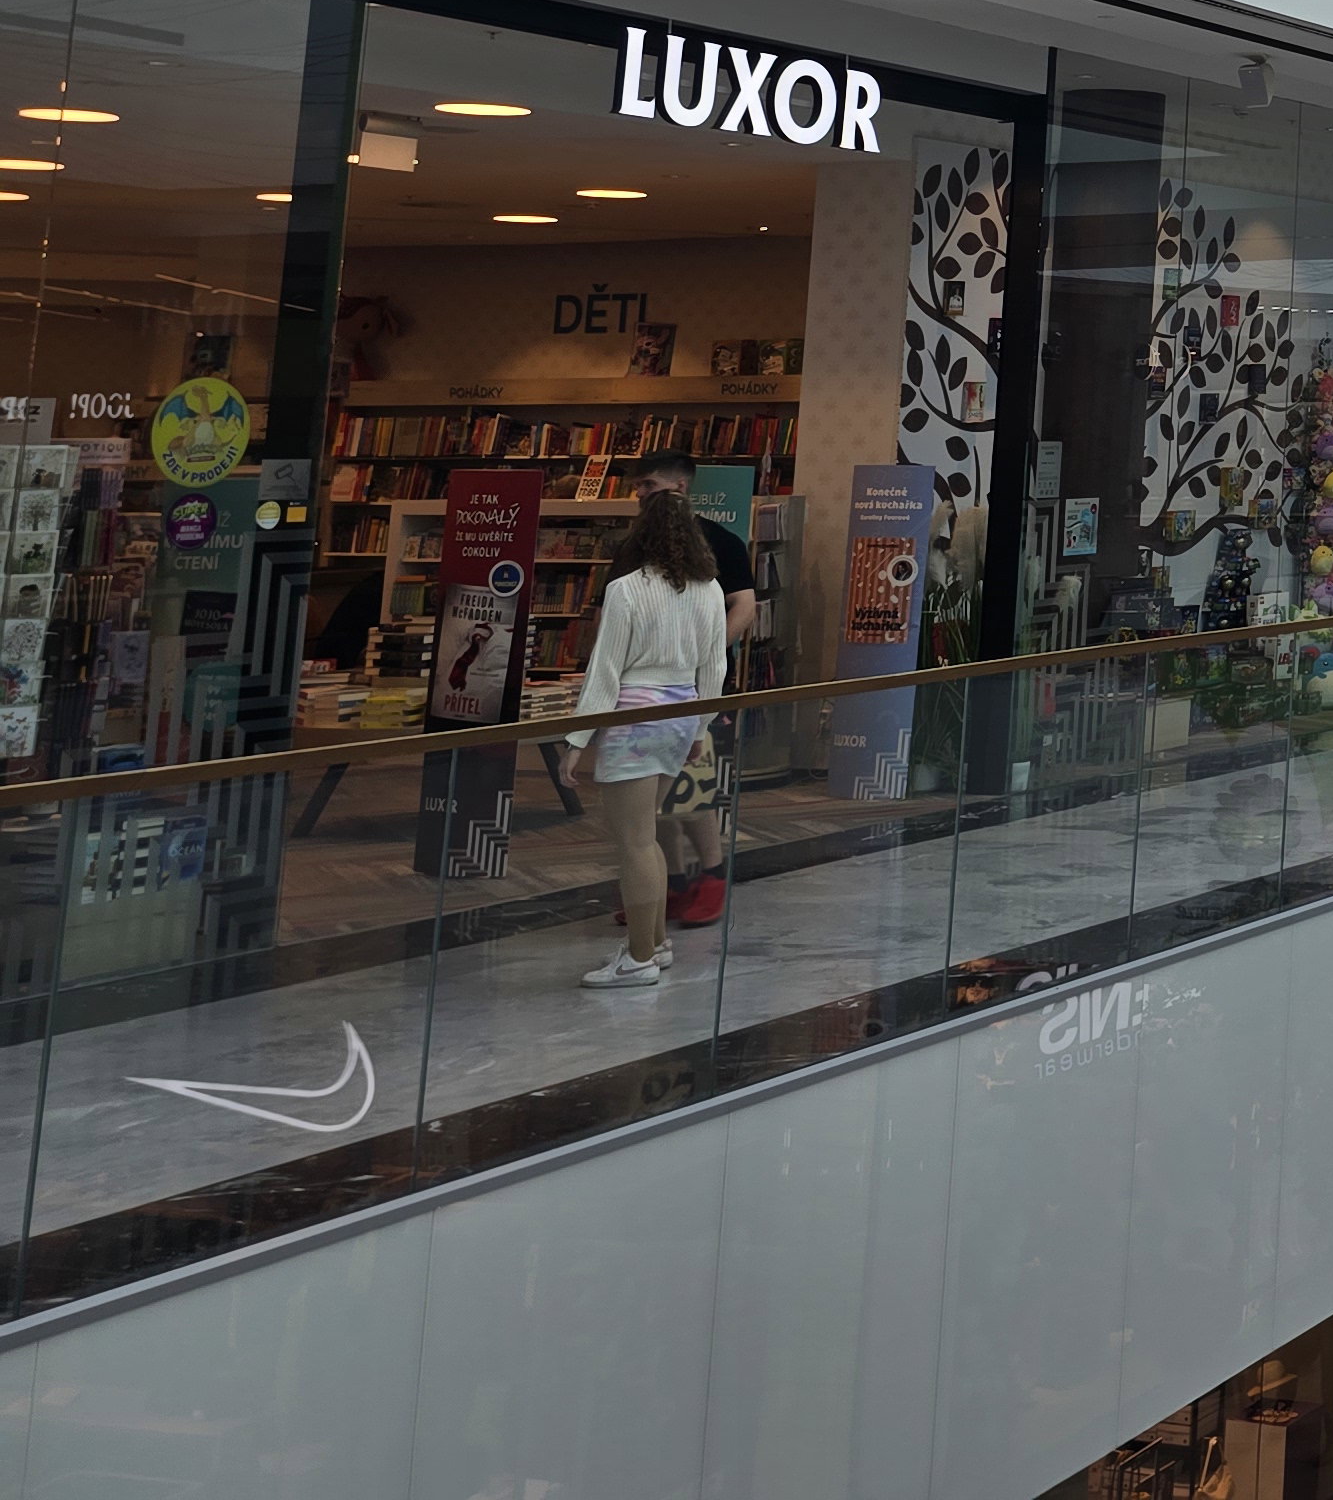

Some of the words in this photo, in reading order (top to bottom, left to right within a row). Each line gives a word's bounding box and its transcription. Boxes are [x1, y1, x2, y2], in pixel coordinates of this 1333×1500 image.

[619, 27, 881, 153] LUXOR
[553, 283, 648, 334] DĚTI
[449, 384, 504, 399] POHÁDKY
[721, 381, 778, 396] POHÁDKY
[163, 451, 182, 475] ZDE
[181, 470, 190, 480] V
[190, 445, 239, 483] PRODEJI!
[470, 494, 480, 505] JE
[482, 494, 500, 505] TAK
[691, 492, 727, 506] EJBLÍŽ
[456, 502, 522, 529] DOKONALÝ,
[694, 509, 738, 523] TNÍMU
[478, 531, 515, 542] UVĚŘÍTE
[462, 546, 501, 558] COKOLIV
[174, 552, 221, 571] ČTENÍ
[460, 593, 495, 609] FREIDA
[444, 691, 481, 716] PŘÍTEL
[834, 734, 867, 748] LUXOR
[425, 796, 458, 814] LUXR
